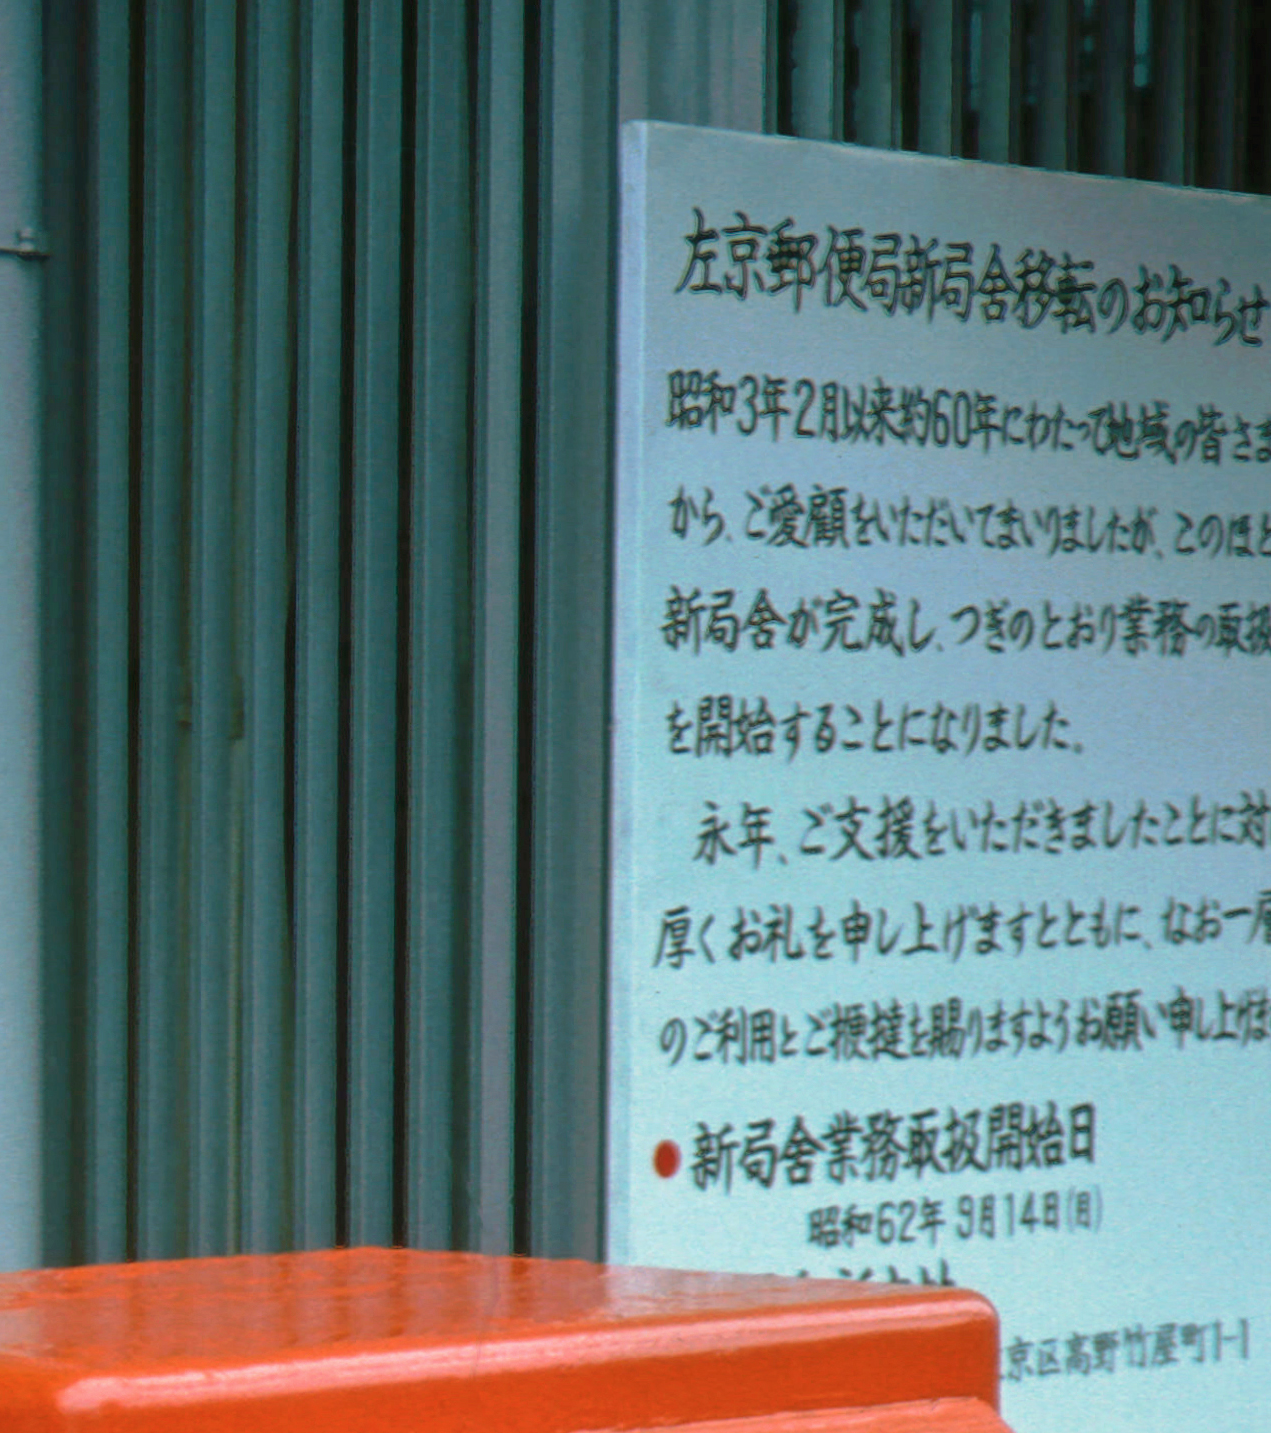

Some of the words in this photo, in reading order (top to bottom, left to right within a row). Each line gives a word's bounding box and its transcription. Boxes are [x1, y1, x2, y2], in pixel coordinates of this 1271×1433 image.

[675, 206, 1270, 346] 左京郵便局新局舎移転のお知らせ
[665, 695, 1083, 763] を開始することになりました。
[690, 1100, 1097, 1194] 新局舎業務取扱開始日
